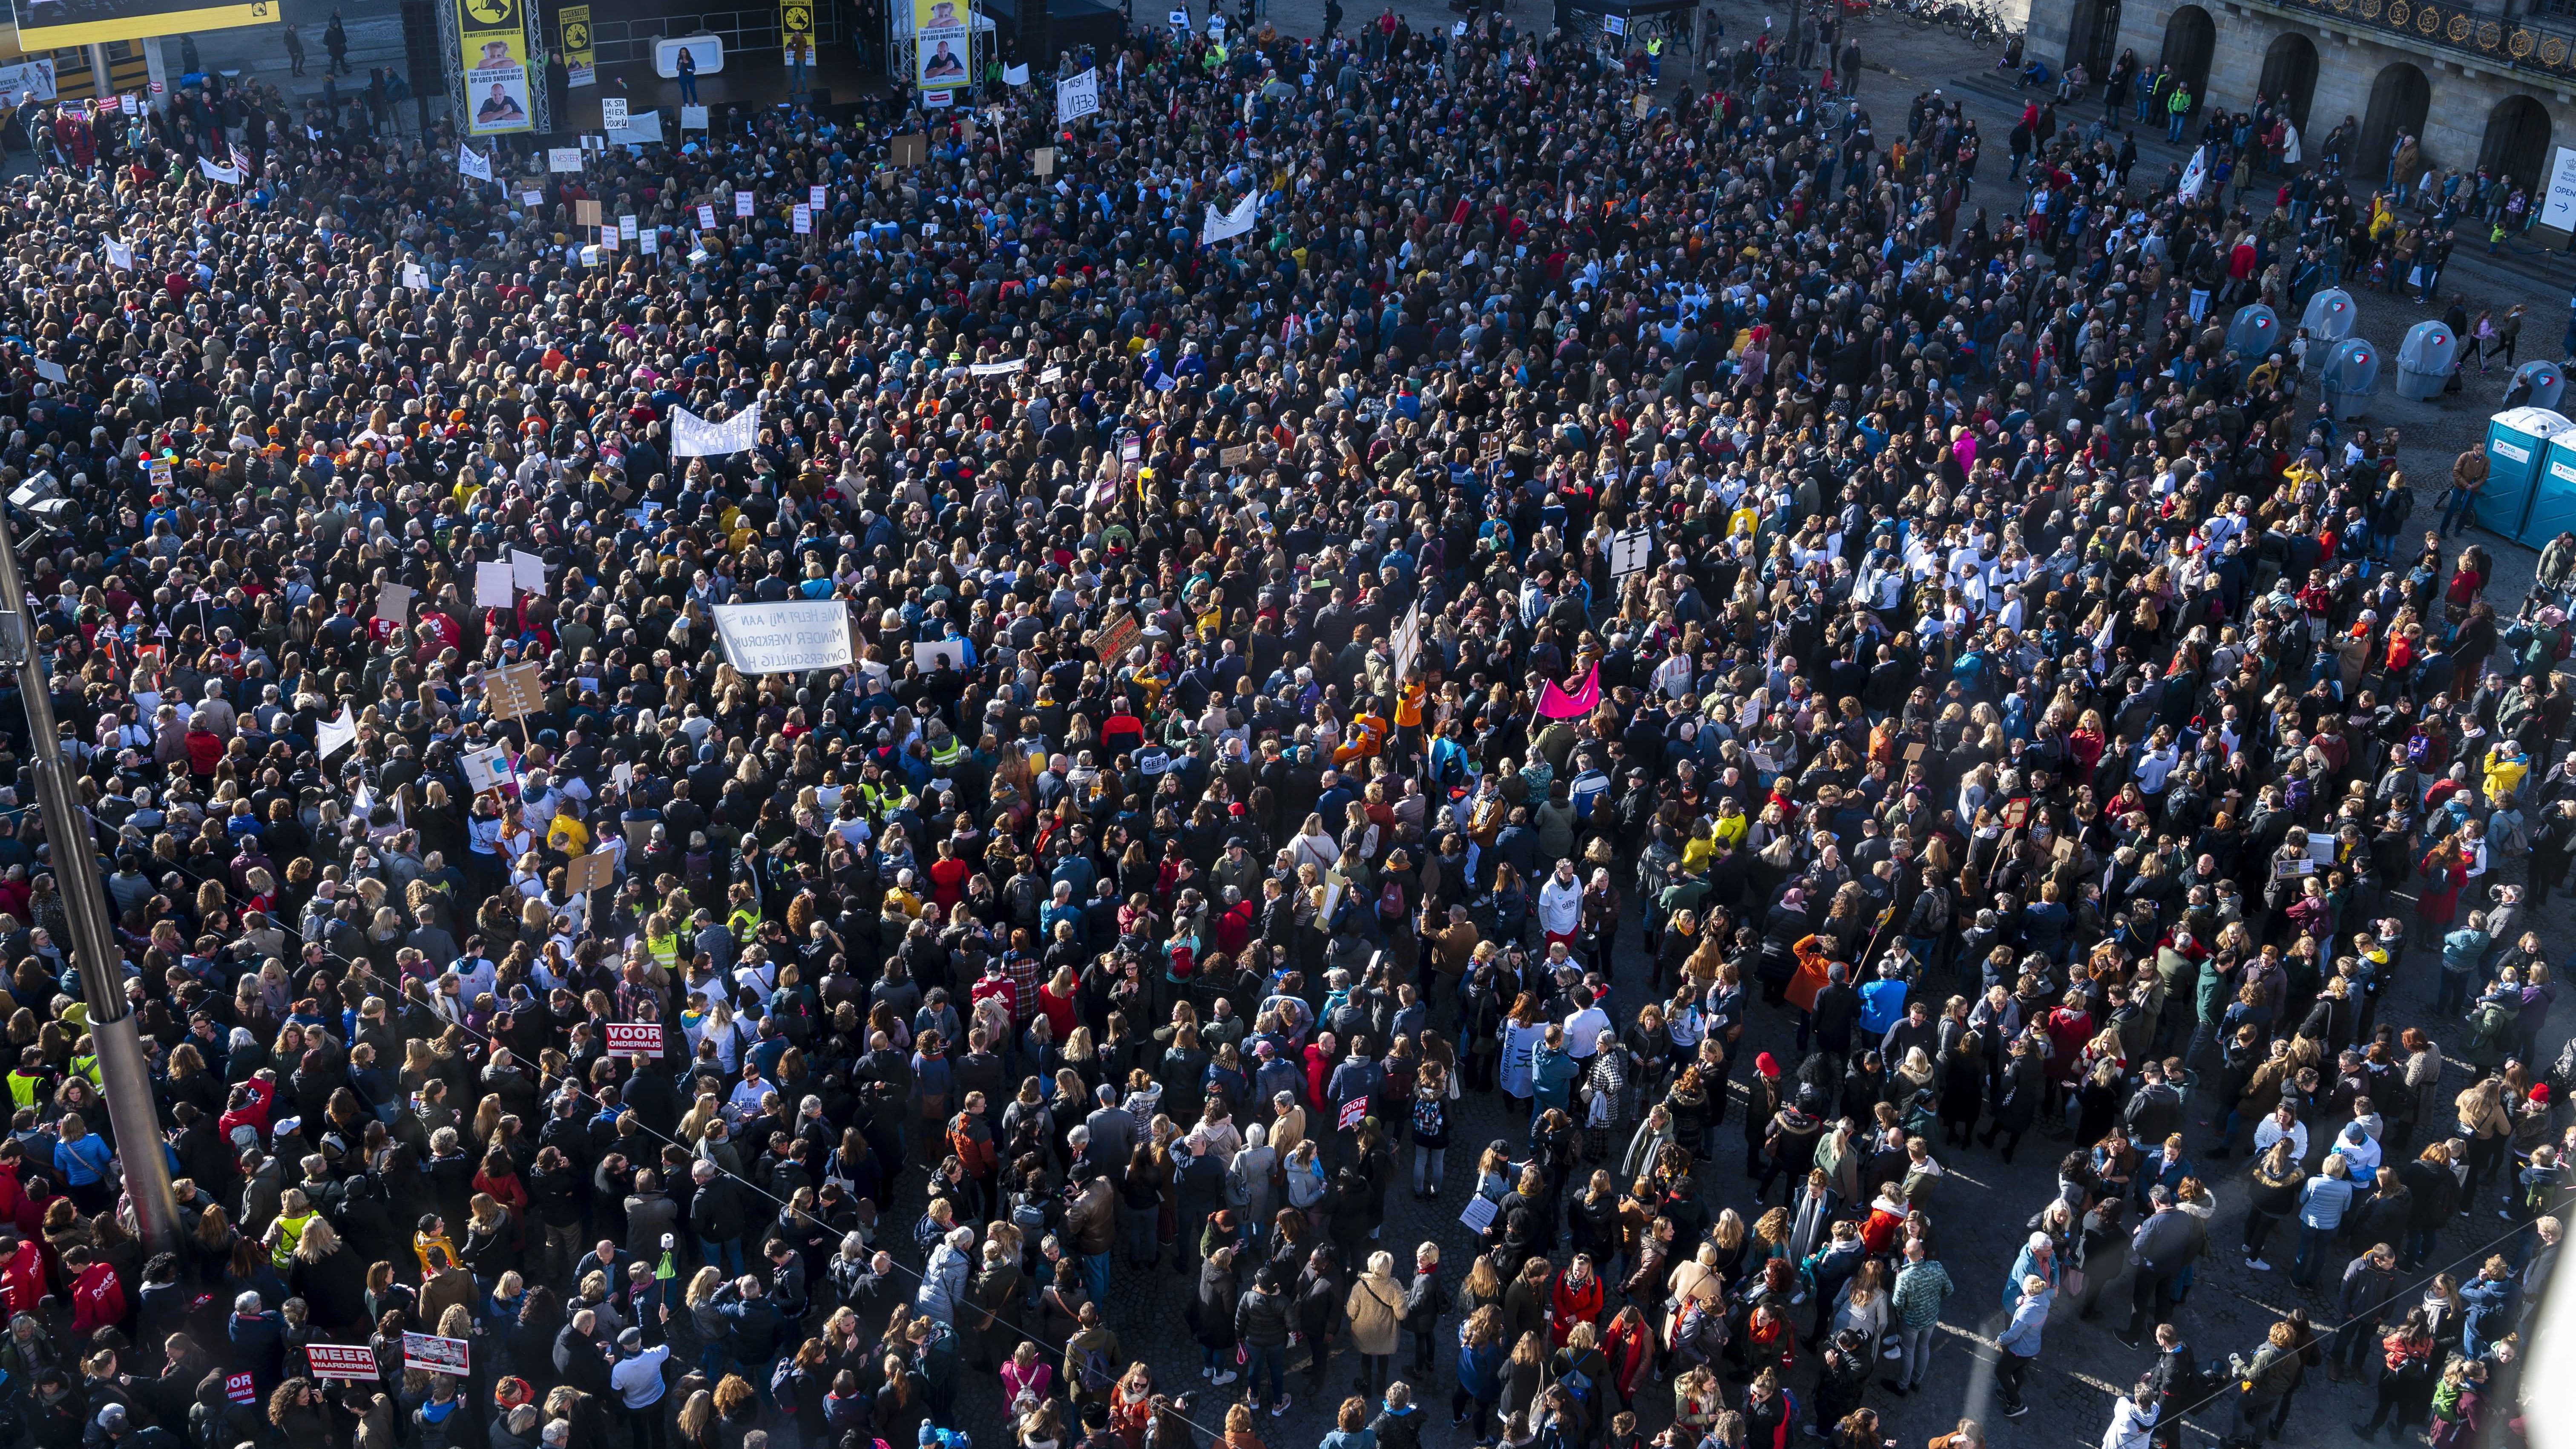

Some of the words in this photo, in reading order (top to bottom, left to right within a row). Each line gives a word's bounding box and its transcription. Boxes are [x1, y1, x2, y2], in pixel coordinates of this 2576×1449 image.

[561, 8, 587, 16] INVESTEER
[463, 29, 521, 38] #INVESTEERINONDERWIJS
[493, 74, 523, 82] ONDERWIJS
[2555, 186, 2576, 197] OPEN
[1113, 619, 1134, 639] SUGAR
[1100, 641, 1118, 662] DADDY
[1144, 757, 1167, 767] GEEN
[1562, 900, 1575, 908] GEEN
[607, 1027, 660, 1039] VOOR
[1508, 1027, 1517, 1043] IKC
[1342, 1098, 1366, 1116] VOOR
[2342, 1150, 2358, 1165] GEEN
[308, 1348, 372, 1362] MEER
[312, 1362, 374, 1370] WAARDERING
[225, 1375, 251, 1390] OR
[228, 1388, 253, 1399] ERWIJS
